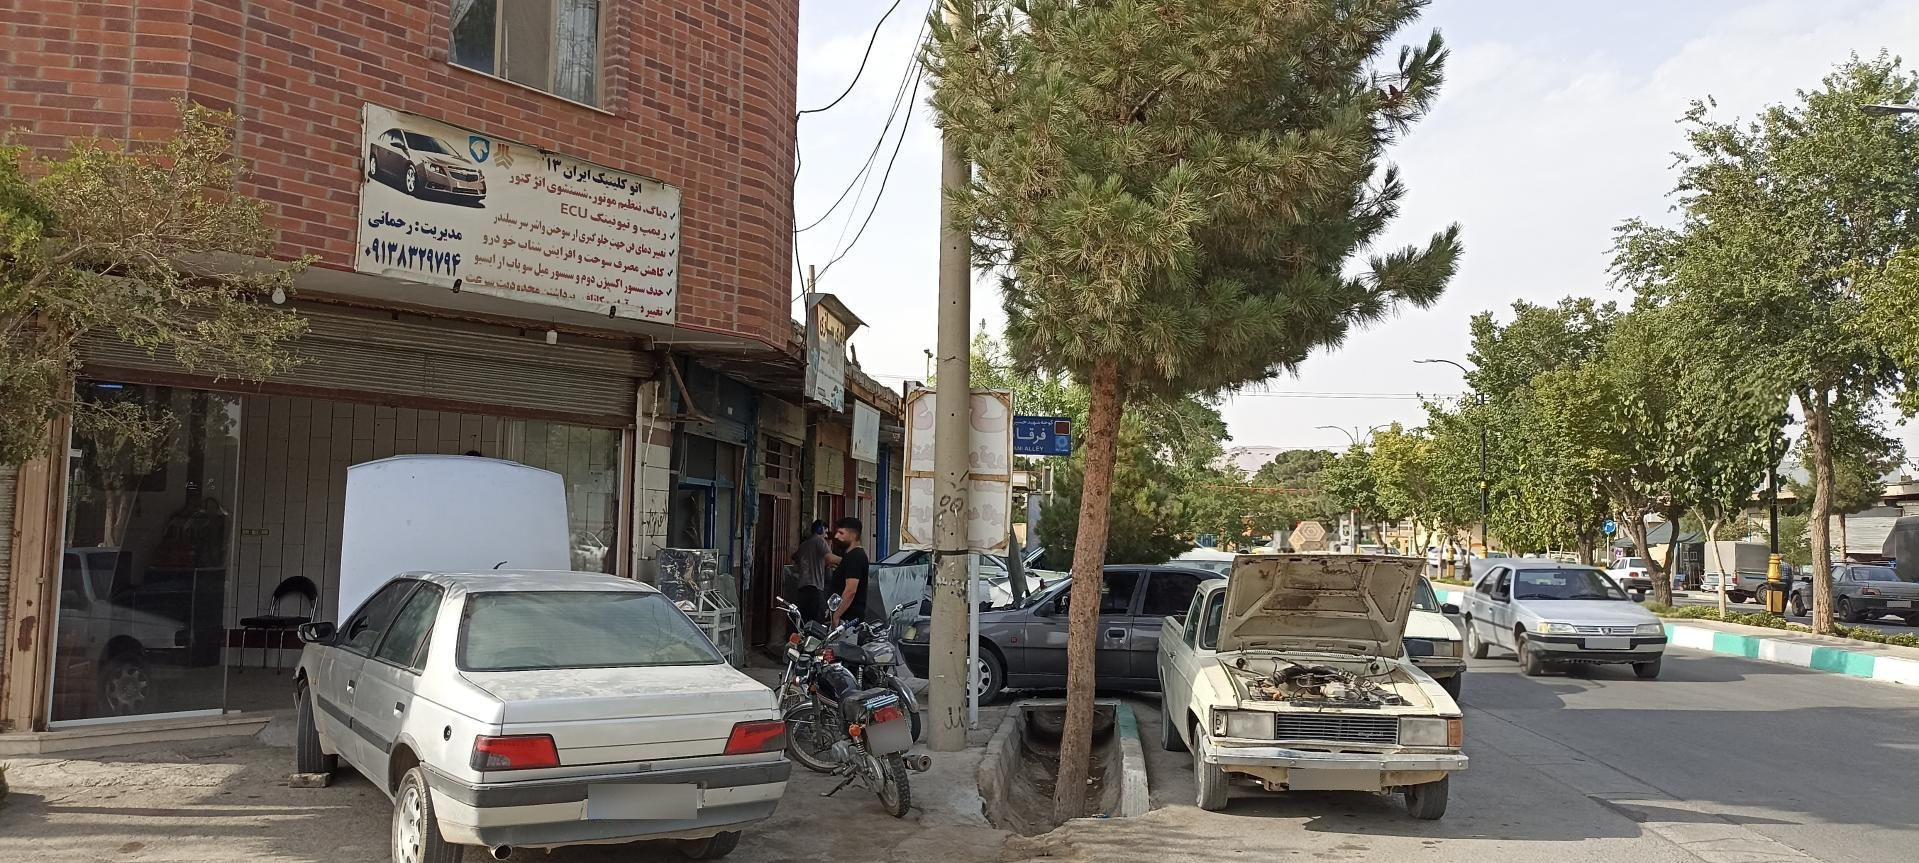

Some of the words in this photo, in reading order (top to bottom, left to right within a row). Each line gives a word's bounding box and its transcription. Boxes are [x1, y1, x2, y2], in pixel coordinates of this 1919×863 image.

[563, 165, 591, 183] ایران
[592, 173, 627, 191] کلینیک
[629, 183, 642, 195] اتو
[618, 197, 641, 211] تنظیم
[560, 203, 588, 219] ECU
[368, 210, 413, 235] رحمانی
[530, 220, 546, 235] واشر
[632, 224, 639, 233] و
[571, 229, 578, 241] از
[518, 239, 542, 252] شتاب
[609, 238, 625, 250] جهت
[626, 242, 635, 253] فن
[635, 244, 651, 256] دمای
[365, 238, 461, 277] ۰۹۱۳۸۳۲۹۷۹۴
[543, 244, 576, 261] افزایش
[578, 254, 583, 264] و
[652, 249, 666, 259] تغییر
[497, 255, 505, 269] از
[584, 253, 612, 269] سوخت
[613, 259, 639, 273] مصرف
[534, 263, 549, 277] میل
[550, 269, 575, 281] سنسور
[640, 265, 665, 277] کاهش
[576, 275, 581, 285] و
[581, 274, 596, 286] دوم
[596, 277, 623, 292] اکسیژن
[624, 284, 645, 295] سنسور
[646, 284, 664, 297] حذف
[645, 306, 663, 318] تغییر
[1016, 427, 1046, 445] فرقا
